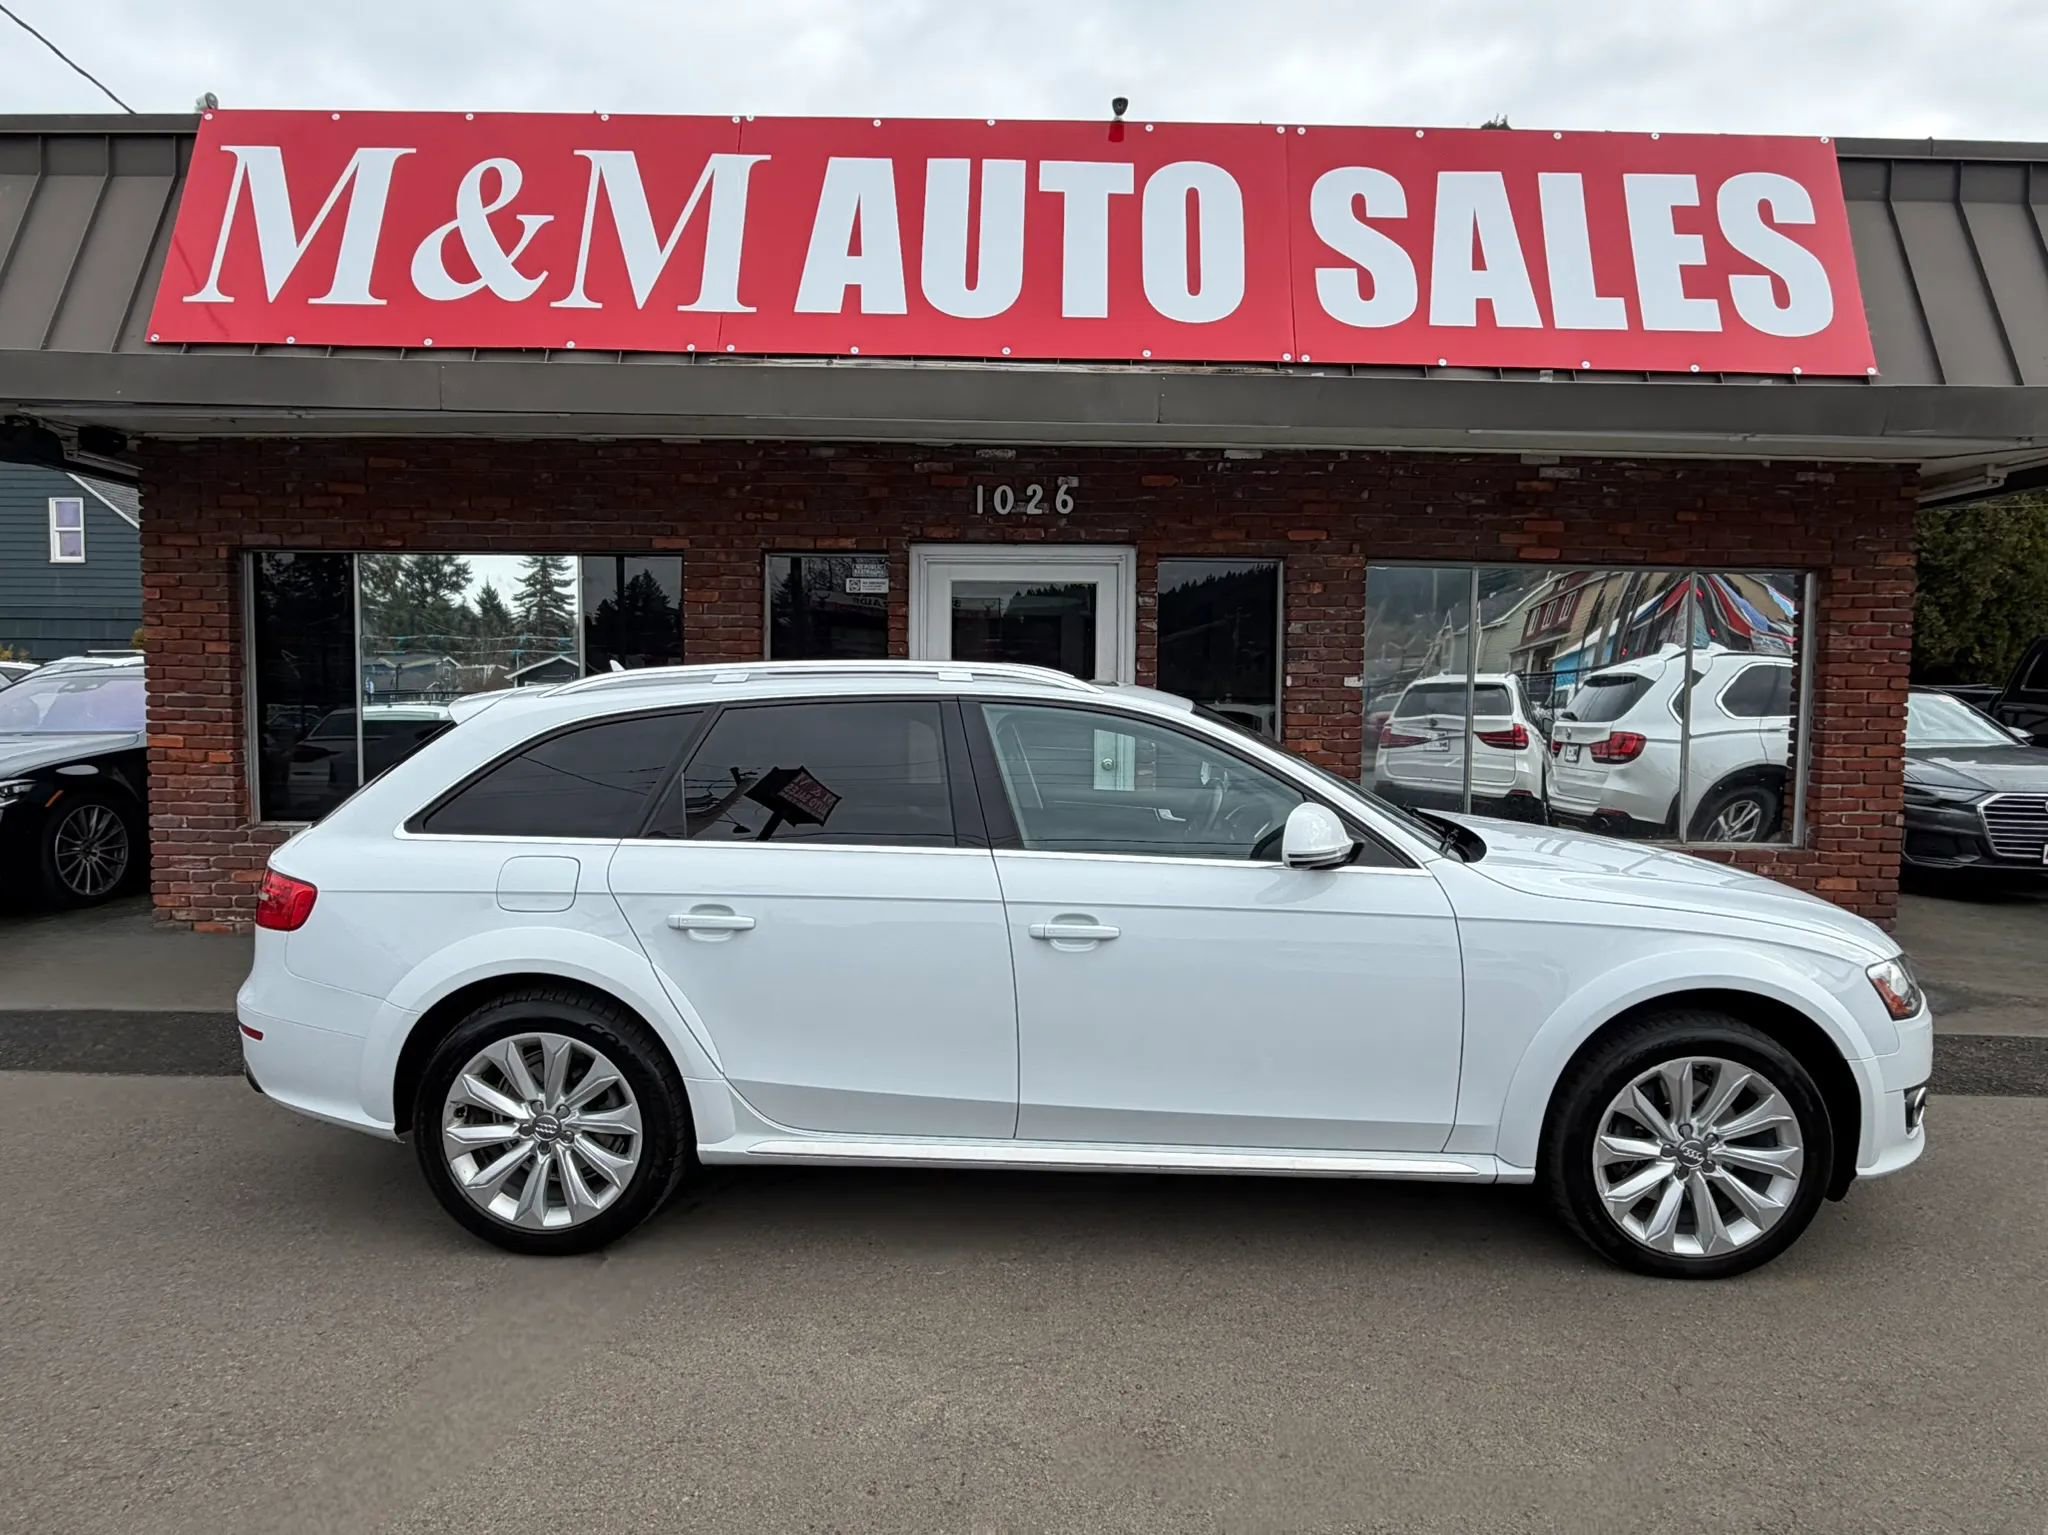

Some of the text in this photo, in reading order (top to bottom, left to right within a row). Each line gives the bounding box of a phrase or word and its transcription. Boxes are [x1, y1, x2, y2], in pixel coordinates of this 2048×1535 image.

[183, 145, 1834, 338] M&M AUTO SALES
[976, 483, 1075, 515] 1026
